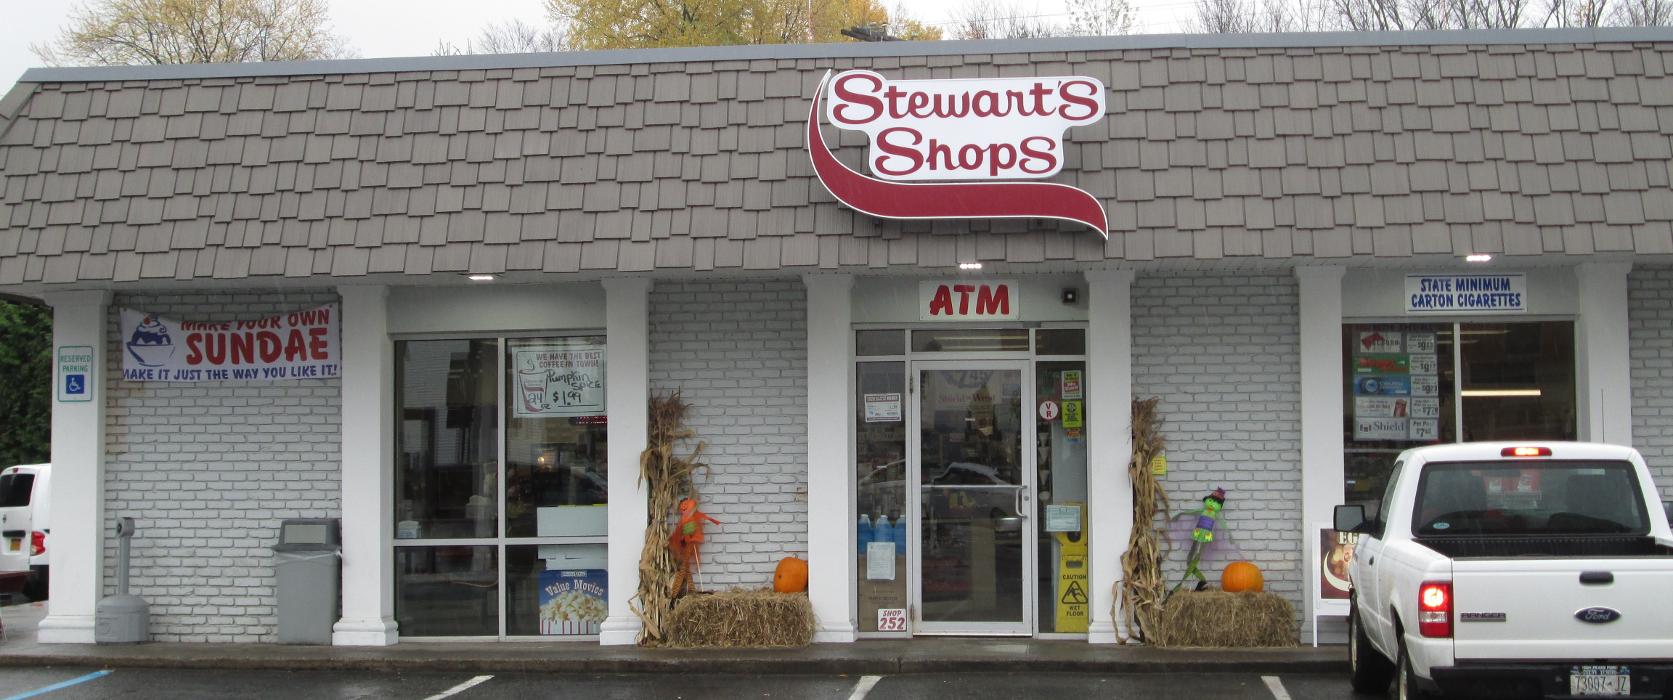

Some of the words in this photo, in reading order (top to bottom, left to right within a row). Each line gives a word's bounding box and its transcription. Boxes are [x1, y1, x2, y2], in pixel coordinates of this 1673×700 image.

[832, 73, 1099, 124] Stewart's
[875, 127, 1057, 176] Shops
[1420, 278, 1452, 292] STATE
[1455, 277, 1511, 292] MINIMUM
[929, 284, 1010, 315] ATM
[1411, 293, 1453, 309] CARTON
[1457, 292, 1521, 308] CIGARETTES
[236, 315, 282, 331] YOUR
[287, 309, 330, 327] OWN
[185, 327, 329, 365] SUNDAE
[60, 355, 92, 363] RESERVED
[536, 353, 548, 361] WE
[549, 353, 568, 361] HAVE
[569, 352, 582, 360] THE
[584, 352, 601, 360] BEST
[539, 360, 566, 369] COFFEE
[565, 360, 574, 368] IN
[157, 369, 170, 381] IT
[173, 369, 202, 381] JUST
[205, 369, 229, 380] THE
[232, 368, 260, 380] WAY
[262, 366, 287, 379] YOU
[290, 365, 317, 378] LIKE
[546, 369, 590, 386] Pumpkin
[545, 582, 570, 596] Value
[574, 578, 604, 596] Movies
[882, 610, 902, 618] SHOP
[1584, 609, 1612, 621] Ford
[879, 617, 906, 630] 252
